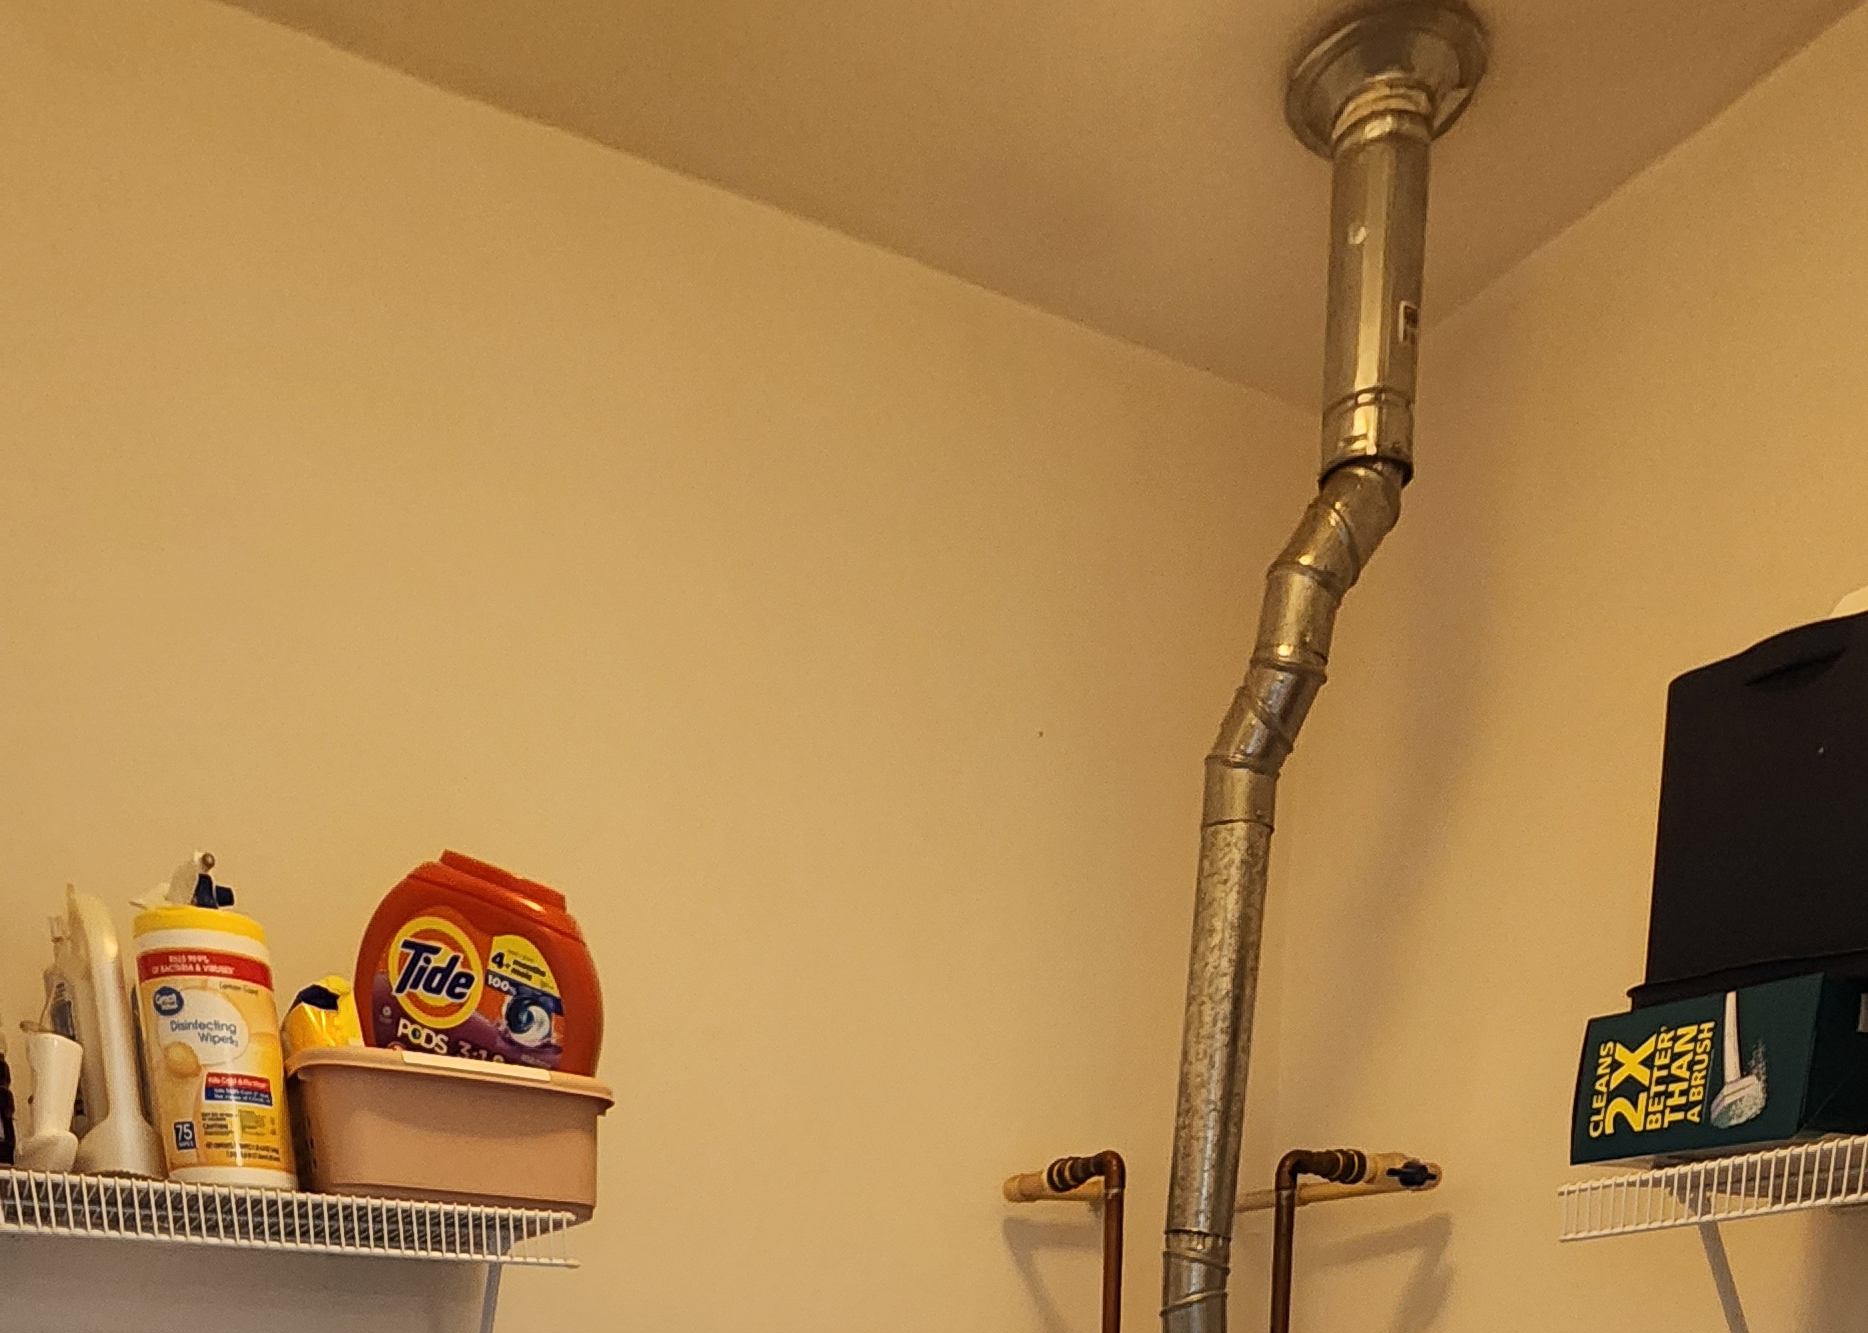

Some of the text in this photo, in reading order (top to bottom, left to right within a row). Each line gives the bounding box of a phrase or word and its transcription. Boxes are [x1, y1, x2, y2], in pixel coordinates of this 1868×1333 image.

[160, 964, 194, 974] BACTERIA
[395, 939, 476, 1000] Tide
[170, 1020, 237, 1034] Disinfecting
[198, 1032, 235, 1046] Wipes
[397, 1018, 449, 1054] PODS
[1589, 1041, 1615, 1138] CLEANS
[1604, 1033, 1657, 1135] 2X
[1663, 1024, 1699, 1128] THAN
[1687, 1021, 1716, 1123] A BRUSH
[175, 1123, 193, 1141] 75
